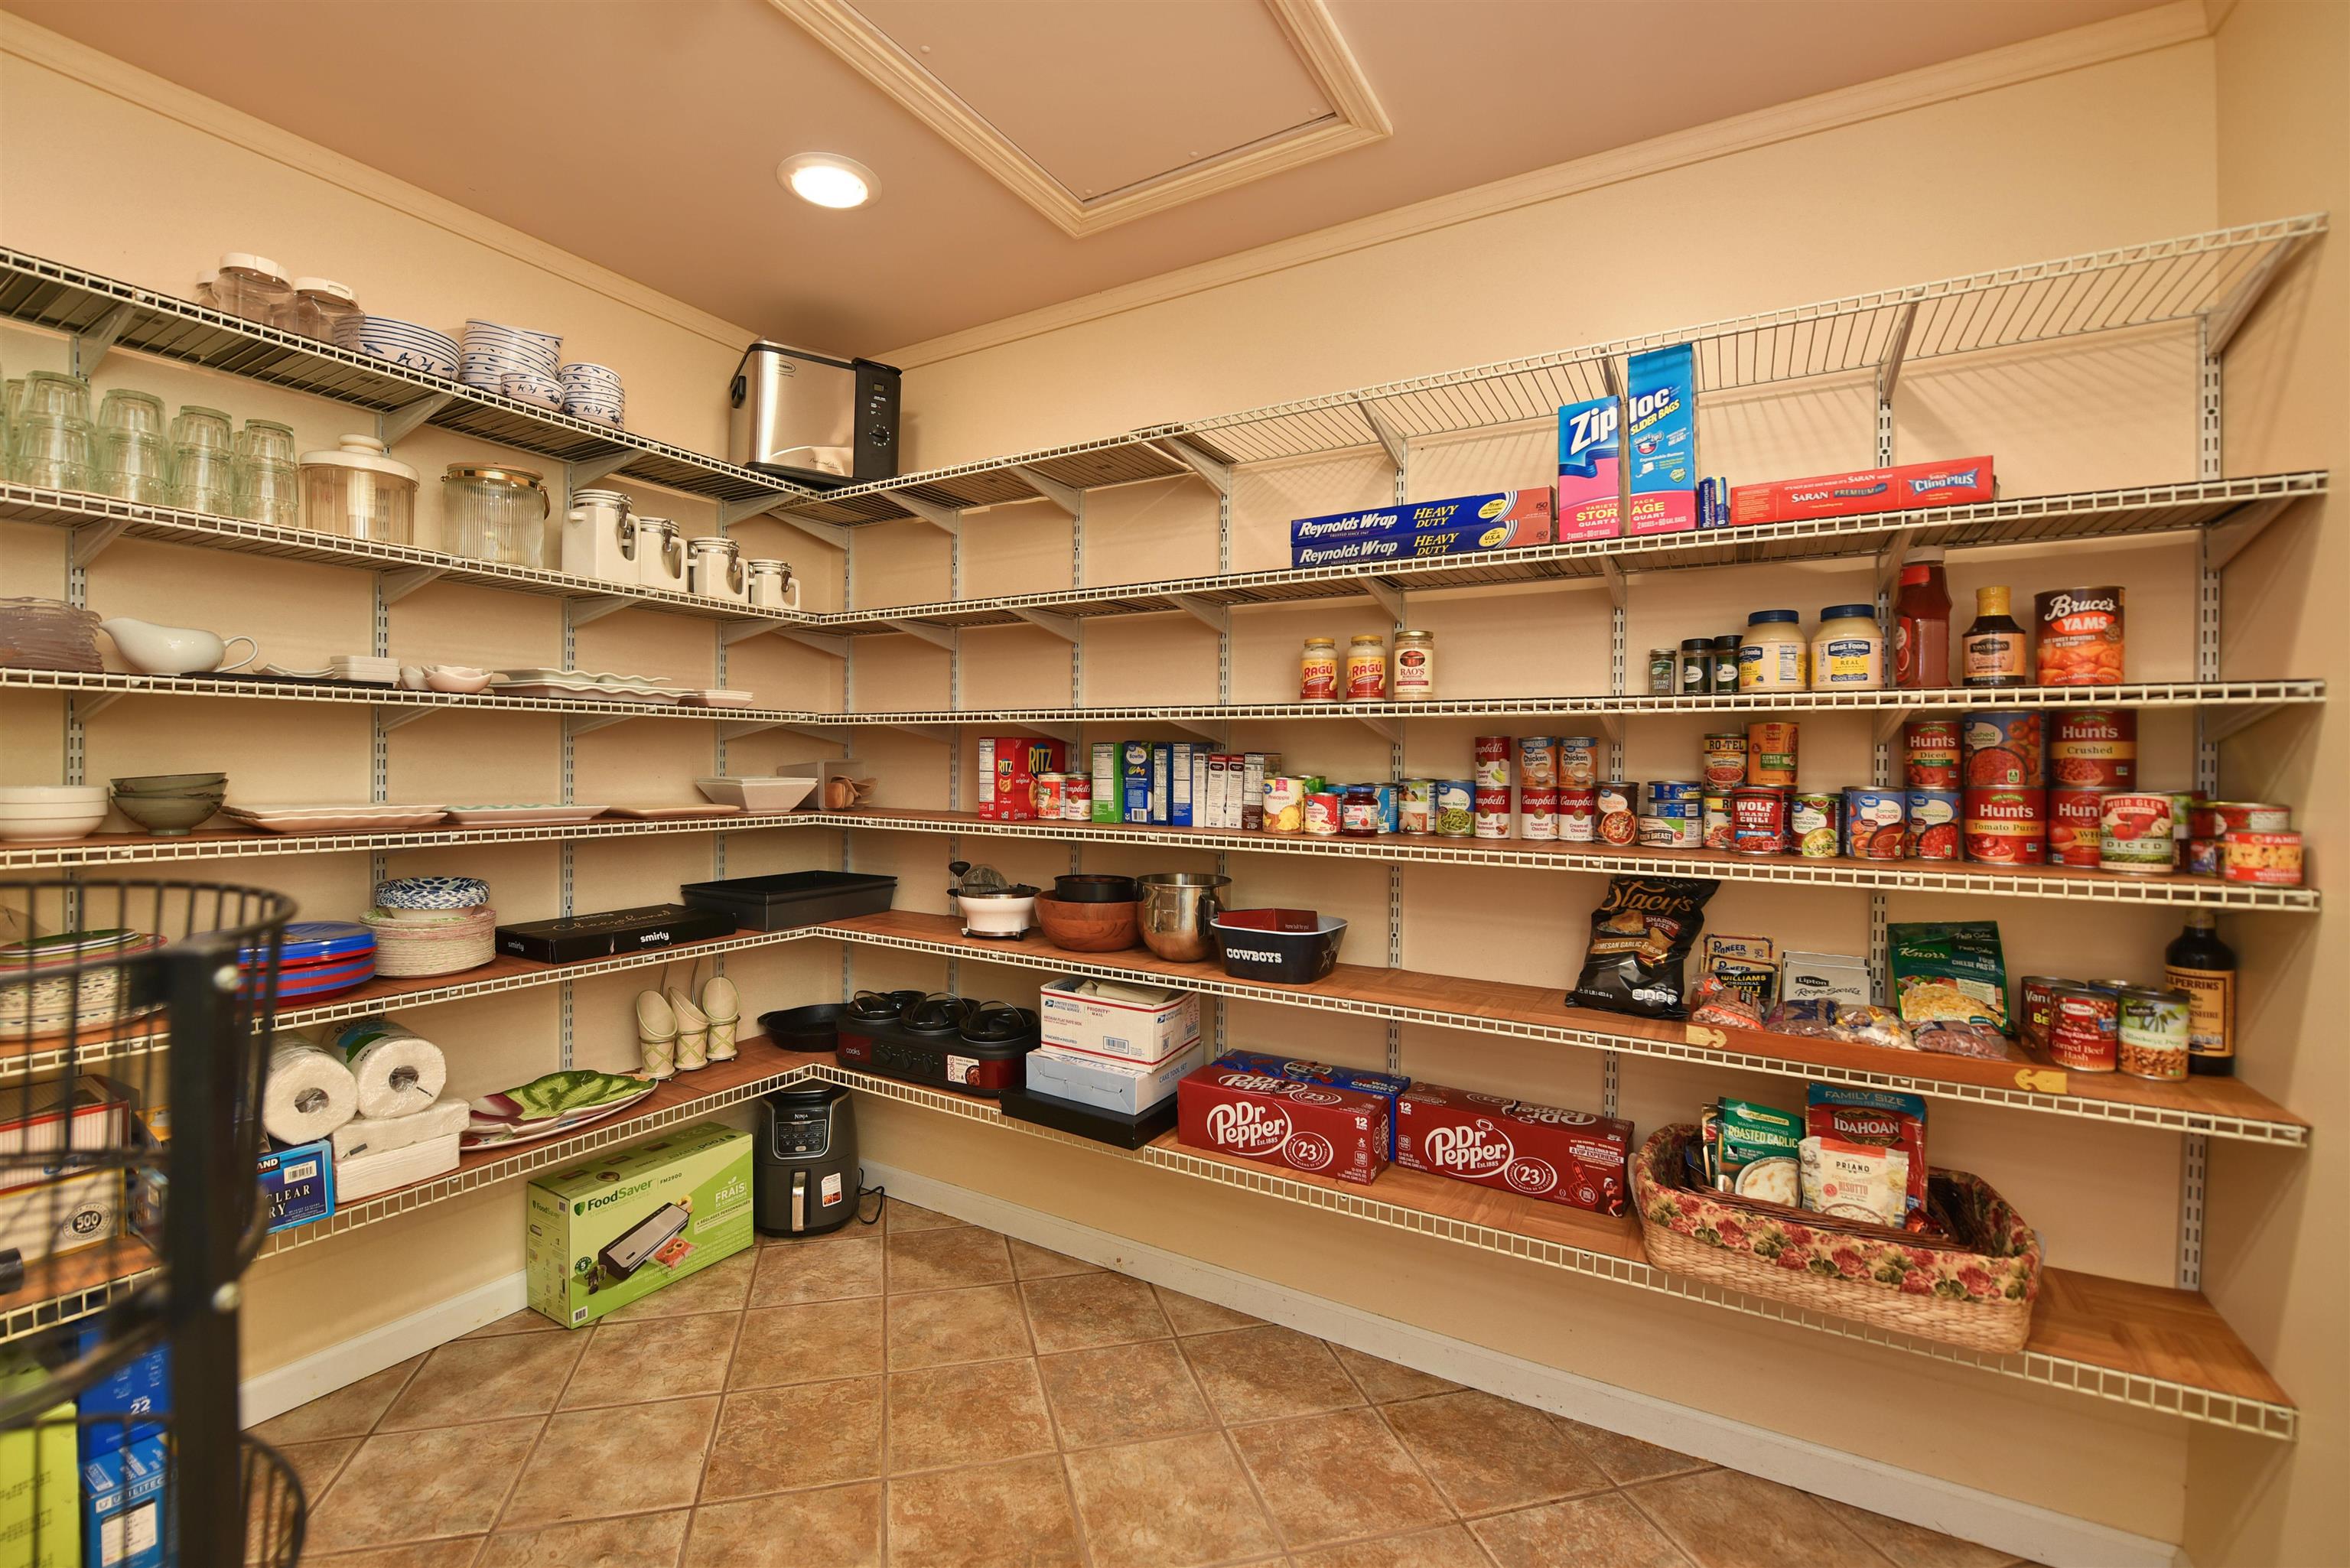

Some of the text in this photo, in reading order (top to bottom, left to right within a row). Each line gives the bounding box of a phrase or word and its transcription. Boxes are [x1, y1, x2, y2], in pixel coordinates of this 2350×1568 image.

[1629, 388, 1669, 424] loc
[1630, 399, 1681, 435] SLIDER BAGS
[1570, 407, 1618, 456] Zip
[1848, 474, 1875, 483] SARAN
[1915, 480, 1946, 492] Cling
[1792, 491, 1828, 503] SARAN
[1413, 505, 1460, 519] HEAVY
[1586, 503, 1619, 511] VARIETY
[1632, 502, 1665, 515] AGE
[1577, 508, 1617, 521] STOR
[1633, 512, 1665, 521] QUART
[1298, 513, 1398, 538] Reynolds Wrap
[1415, 517, 1450, 529] DUTY
[1414, 532, 1460, 547] HEAVY
[1299, 540, 1398, 564] Reynolds Wrap
[1416, 545, 1448, 556] DUTY
[2044, 594, 2116, 621] Bruce's
[2062, 616, 2108, 631] YAMS
[1304, 663, 1333, 679] RAGÚ
[1352, 661, 1382, 678] RAGÚ
[1401, 668, 1424, 676] RAO'S
[998, 760, 1013, 773] RITZ
[1028, 747, 1053, 773] RITZ
[1736, 802, 1774, 812] WOLF
[2107, 799, 2163, 809] MUIR GLEN
[1600, 880, 1694, 916] Stacy's
[1646, 917, 1678, 929] SHARING
[640, 931, 669, 942] smirly
[508, 941, 524, 952] smirly
[1648, 945, 1662, 955] HERB
[1713, 941, 1746, 954] PIONEER
[1226, 948, 1282, 963] COWBOYS
[1898, 948, 1948, 959] Knorr
[1976, 962, 1996, 971] PASTA
[2176, 977, 2218, 990] PERRINS
[1795, 987, 1825, 997] Recipe
[2026, 991, 2046, 1003] Van
[2056, 1029, 2072, 1037] Mary
[846, 1047, 861, 1056] cooks
[2052, 1041, 2104, 1054] Corned Beef
[2065, 1051, 2088, 1061] Hash
[1159, 1073, 1170, 1083] CAKE
[1171, 1069, 1180, 1078] TOOL
[1351, 1081, 1395, 1093] CHERRY
[1372, 1080, 1398, 1089] WILD
[1824, 1091, 1871, 1100] FAMILY
[1875, 1094, 1906, 1106] SIZE
[1236, 1101, 1265, 1124] Dr
[1400, 1101, 1411, 1111] 12
[1210, 1104, 1285, 1147] Pepper
[1355, 1117, 1368, 1127] 12
[1834, 1117, 1899, 1134] IDAHOAN
[1456, 1126, 1486, 1146] Dr
[1729, 1125, 1798, 1148] ROASTED GARLIC
[1761, 1125, 1789, 1135] POTATOES
[1298, 1141, 1317, 1160] 23
[1433, 1127, 1507, 1170] Pepper
[1587, 1150, 1621, 1163] EXPERIENCE
[1836, 1161, 1870, 1173] PRIANO
[1520, 1166, 1540, 1185] 23
[588, 1173, 682, 1211] FoodSaver FM2900
[715, 1183, 745, 1202] FRAIS
[1838, 1181, 1868, 1195] RISOTTO
[721, 1192, 747, 1207] LONGTEMPS
[537, 1203, 560, 1218] FoodSaver
[701, 1199, 750, 1224] RÉGLAGES PERSONNALISÉS
[76, 1213, 98, 1229] 500
[131, 1398, 151, 1415] 22
